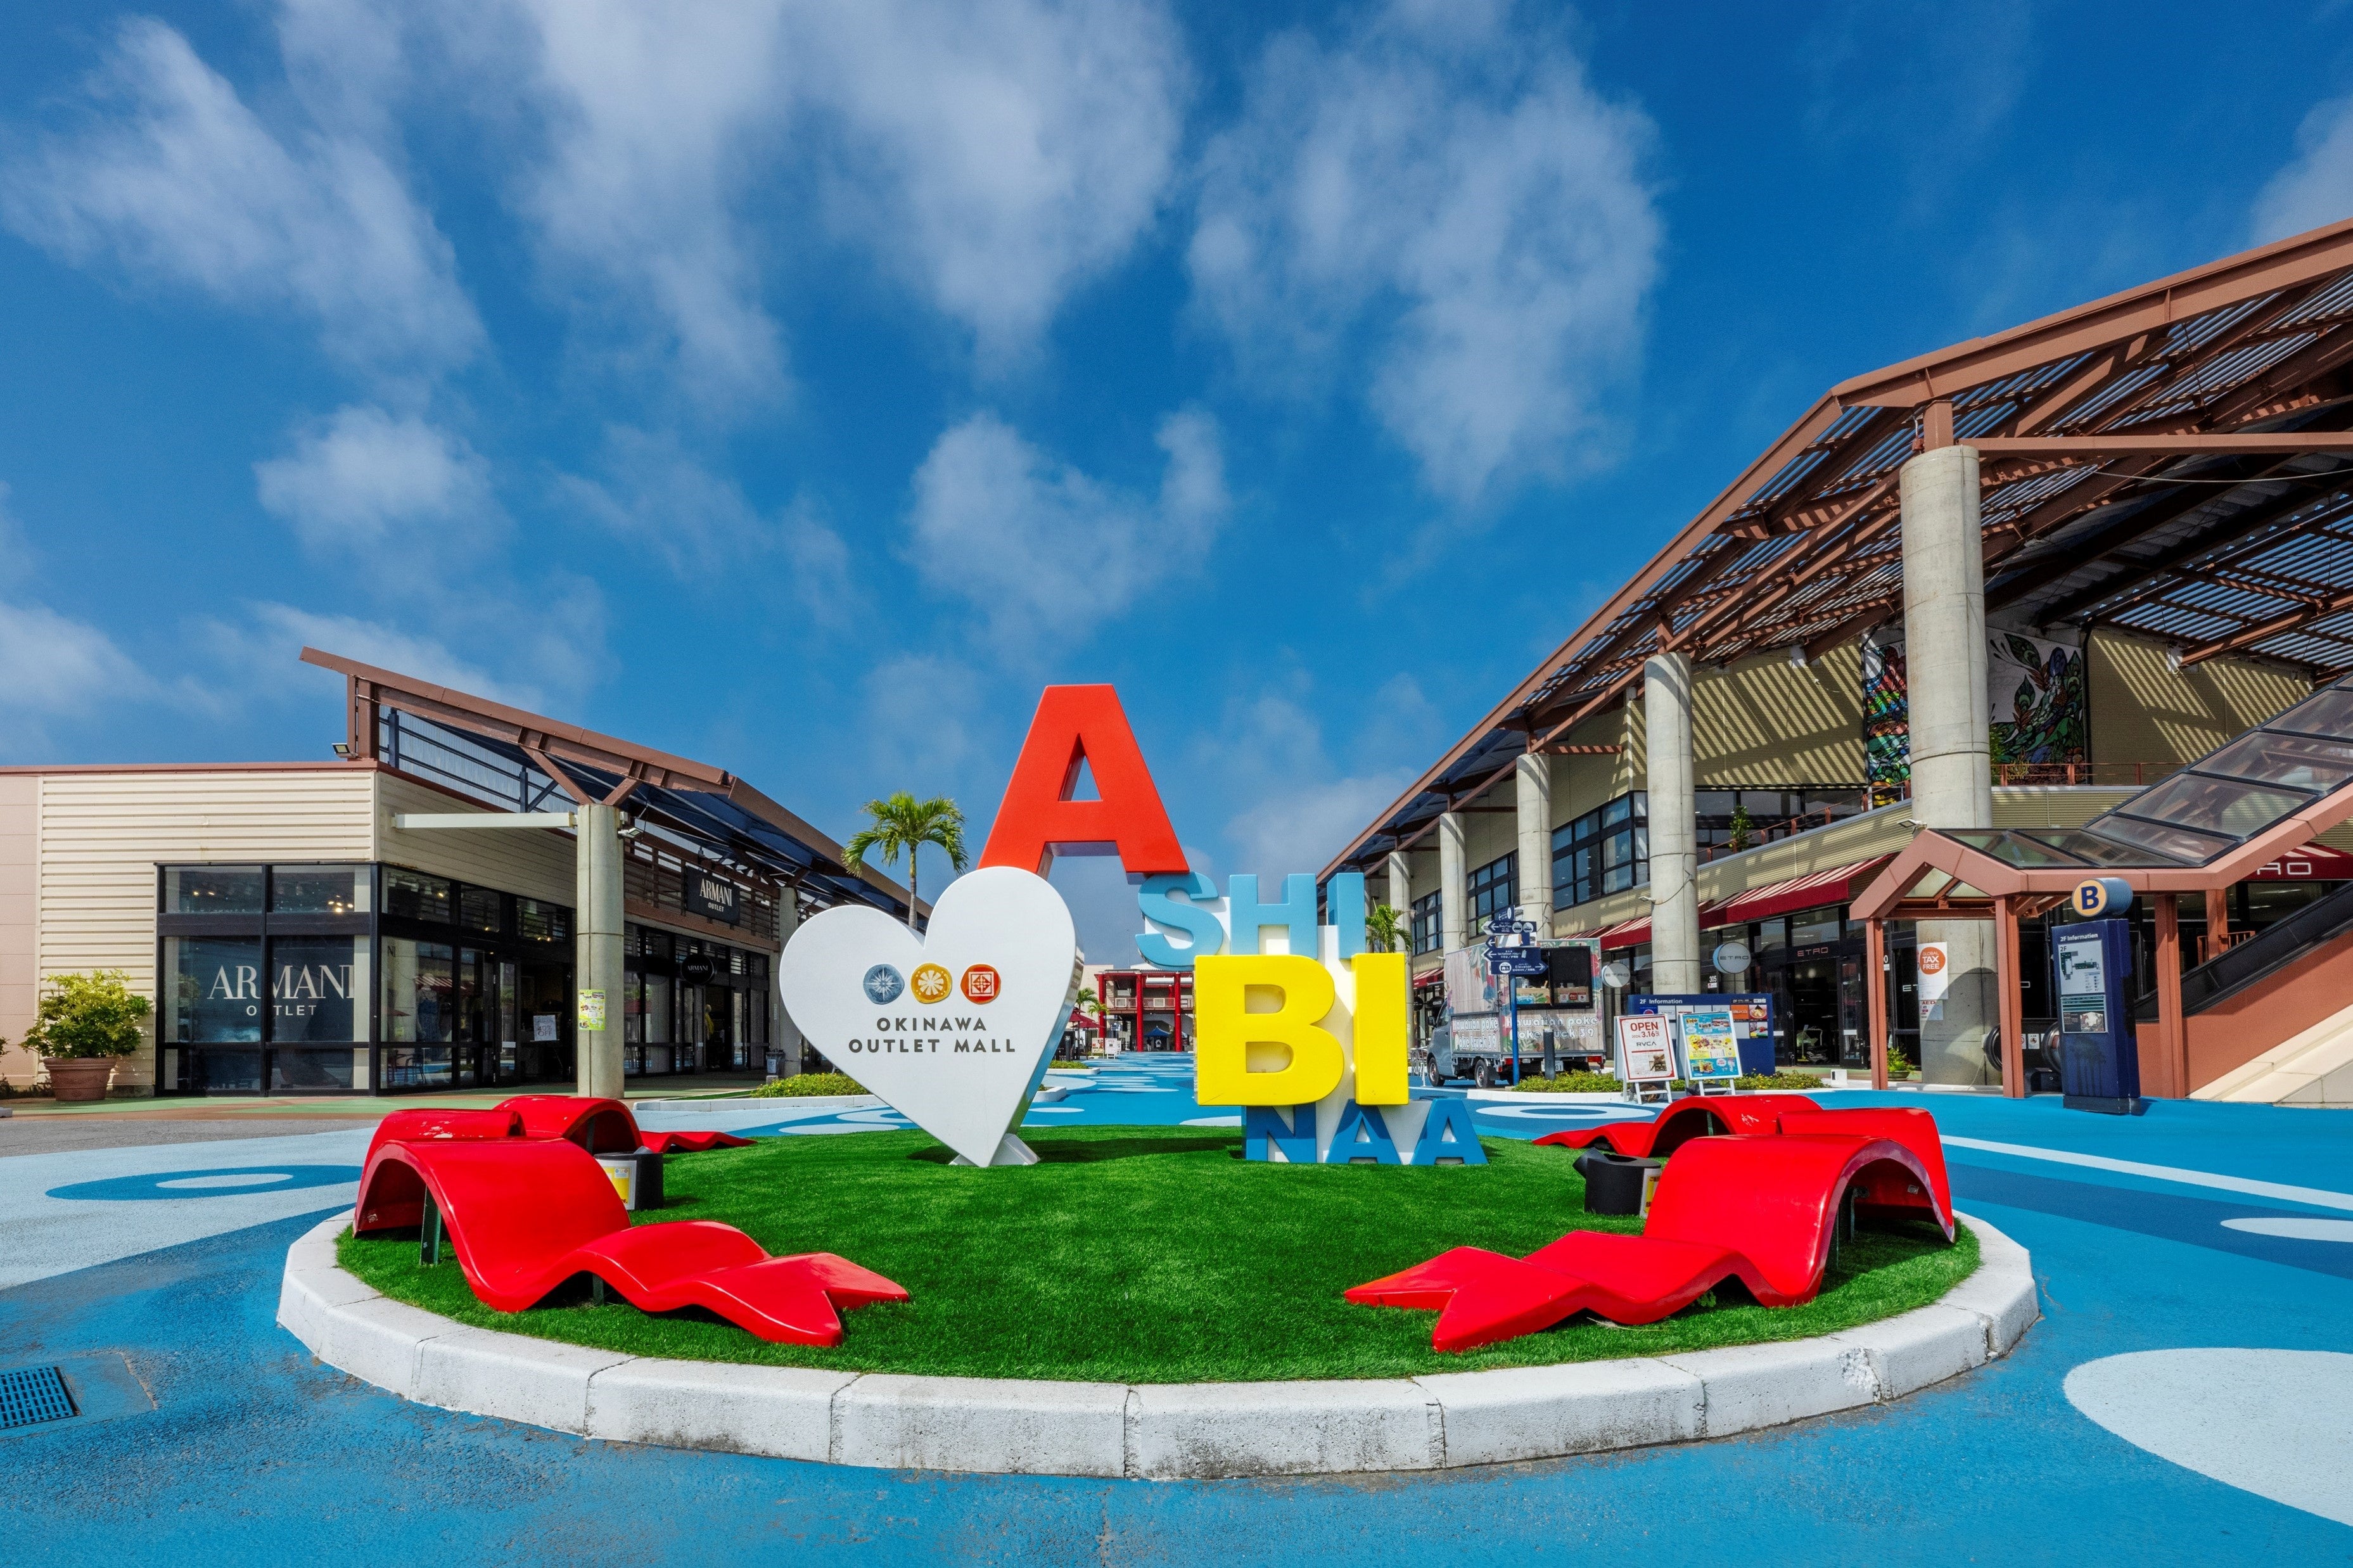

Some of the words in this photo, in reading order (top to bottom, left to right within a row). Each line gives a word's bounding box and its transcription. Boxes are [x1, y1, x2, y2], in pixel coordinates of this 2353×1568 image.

[976, 684, 1190, 874] A
[699, 878, 732, 907] ARMANI
[2081, 886, 2100, 910] B
[708, 902, 724, 912] OUTLET
[1135, 872, 1366, 969] SHI
[2067, 933, 2098, 941] Information
[1797, 947, 1828, 957] ETRO
[207, 964, 355, 999] ARMANI
[246, 1005, 317, 1016] OTLET
[877, 1017, 986, 1031] OKINAWA
[1567, 1014, 1598, 1029] poke
[1630, 1021, 1659, 1031] OPEN
[1195, 952, 1409, 1106] BI
[1579, 1026, 1595, 1038] 39
[848, 1039, 940, 1053] OUTLET
[954, 1039, 1016, 1052] MALL
[1241, 1097, 1489, 1164] NAA
